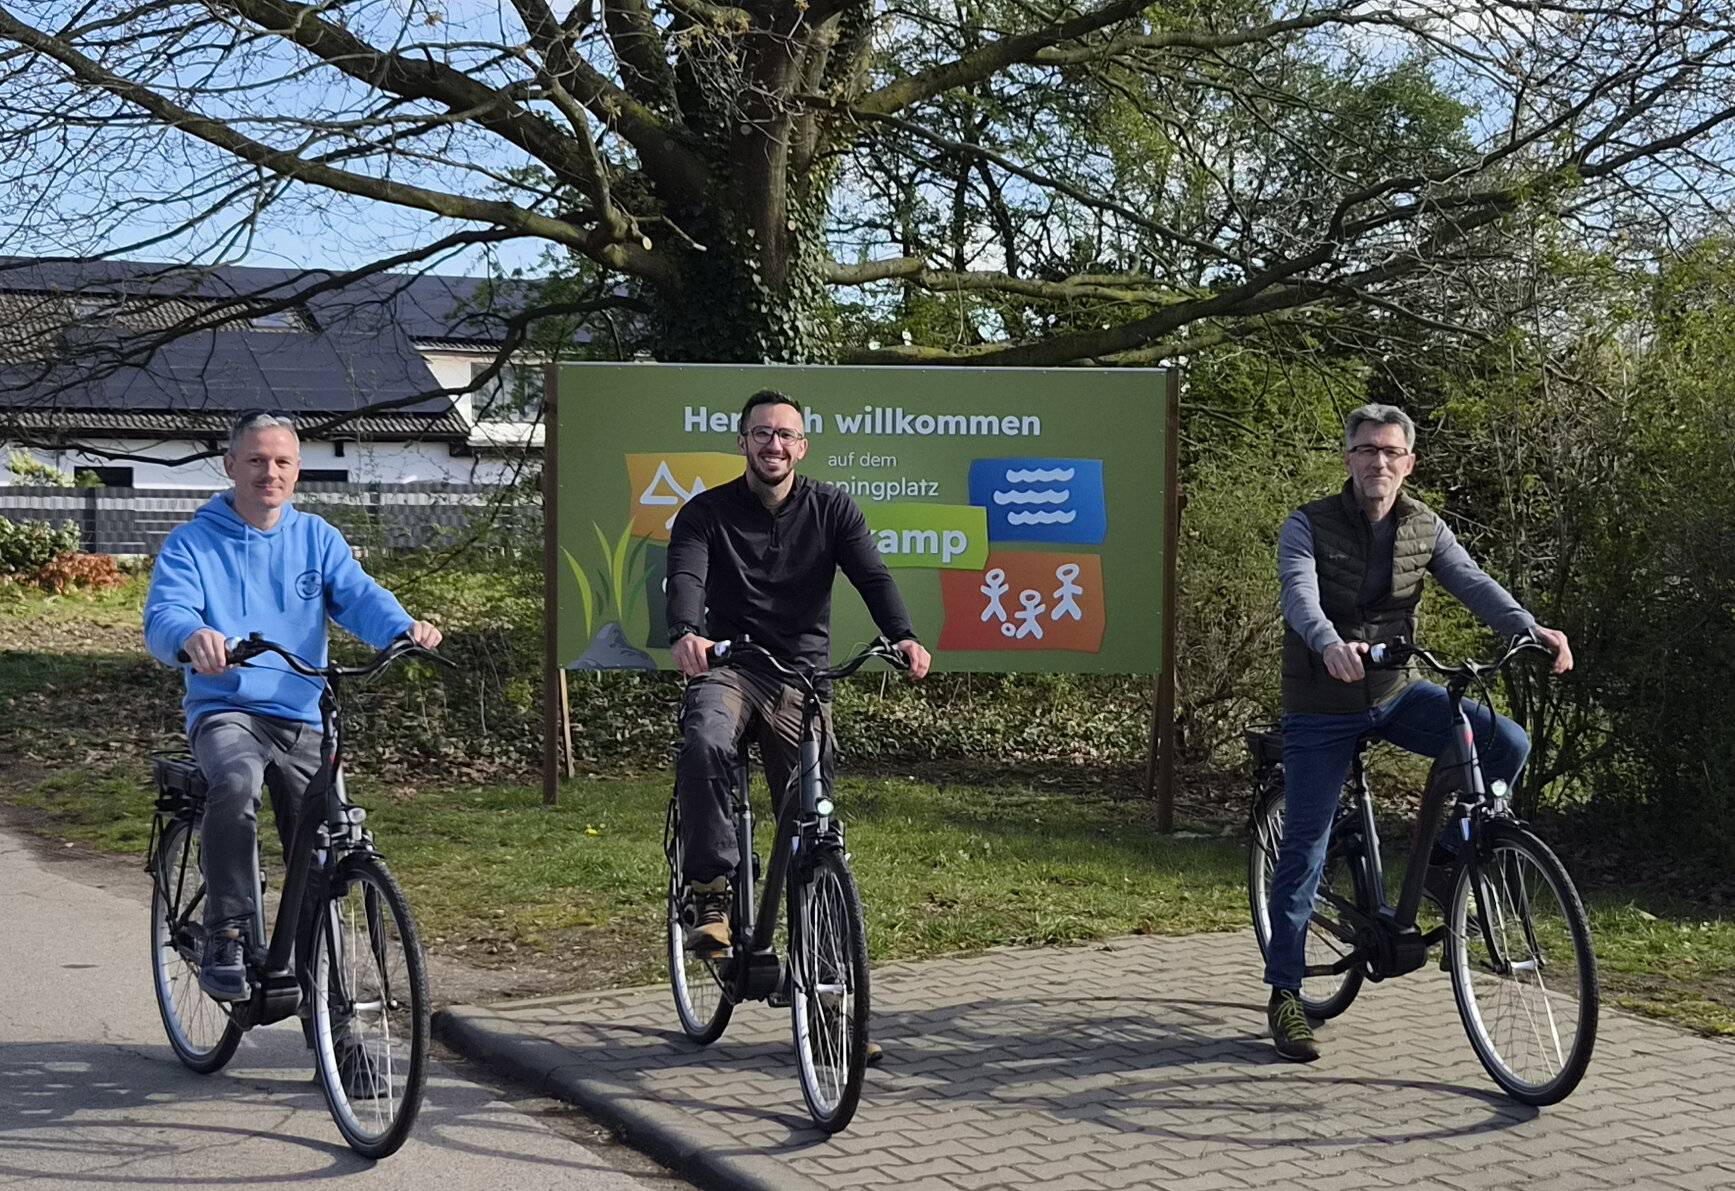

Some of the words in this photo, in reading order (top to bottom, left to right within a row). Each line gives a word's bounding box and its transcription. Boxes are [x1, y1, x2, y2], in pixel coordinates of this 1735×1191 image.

[685, 406, 823, 433] Herh
[835, 405, 1041, 436] willkommen
[828, 452, 854, 467] auf
[859, 452, 897, 467] dem
[823, 475, 939, 501] pingplatz
[871, 529, 968, 563] amp
